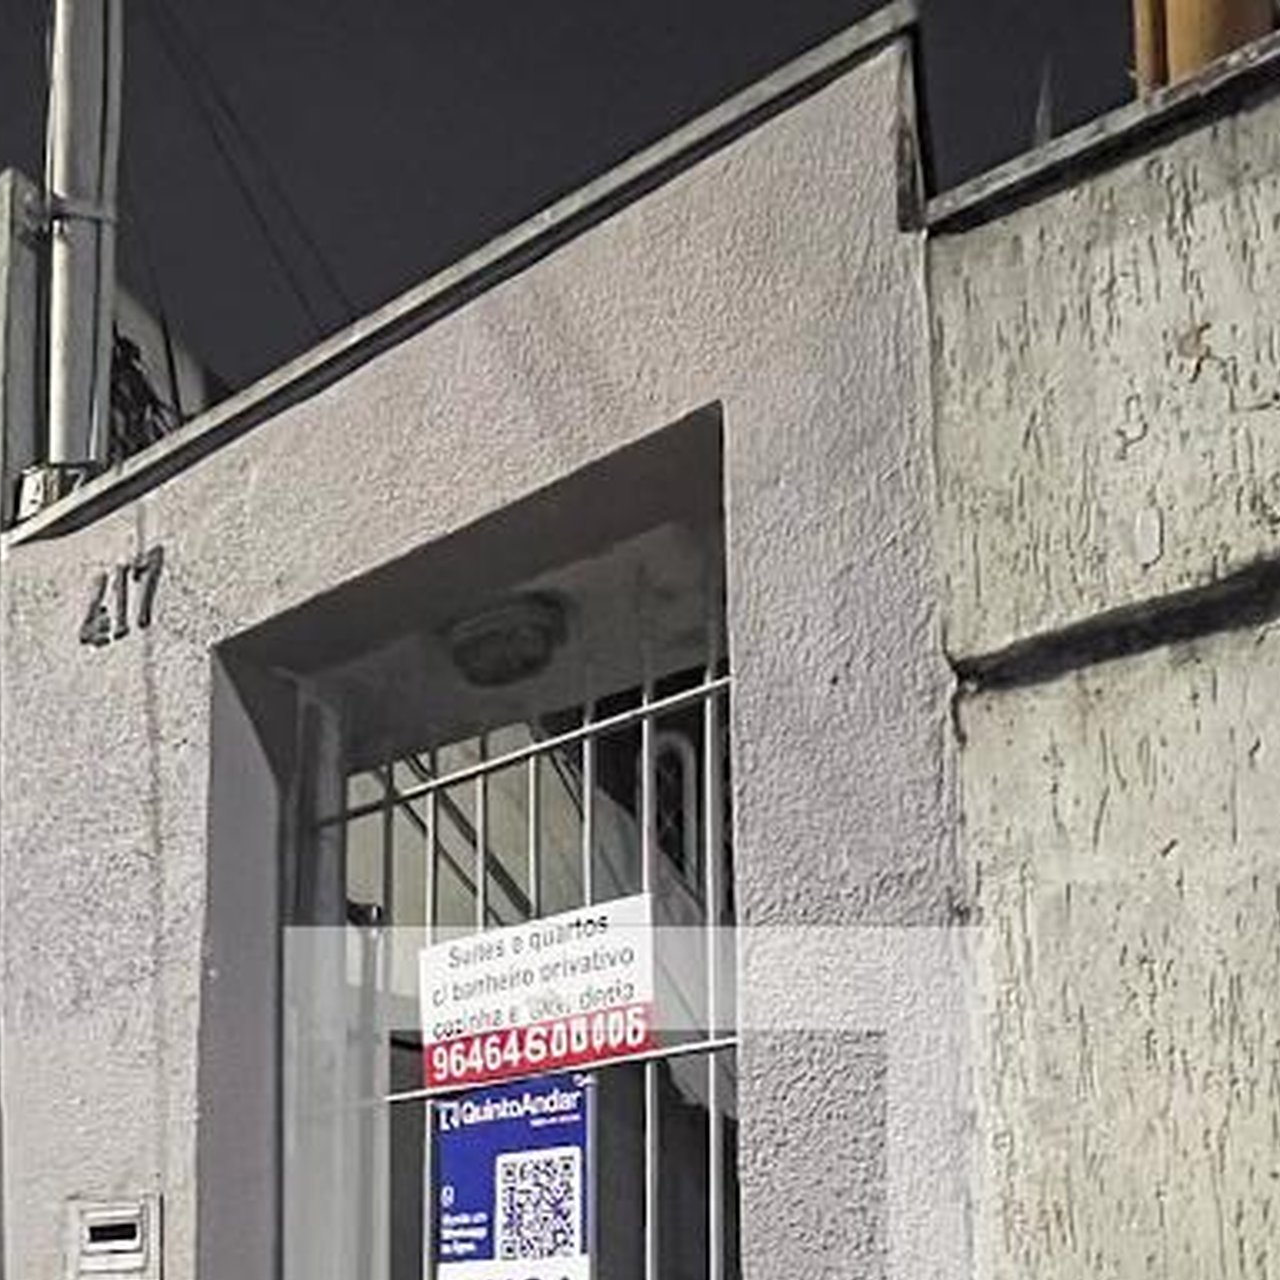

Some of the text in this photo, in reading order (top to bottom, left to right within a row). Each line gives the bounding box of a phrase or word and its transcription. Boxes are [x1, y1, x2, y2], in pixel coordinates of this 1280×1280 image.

[528, 915, 609, 953] quartos
[452, 962, 535, 1003] banheiro
[539, 945, 635, 983] privativo
[432, 1007, 503, 1041] cozinha
[461, 1088, 582, 1125] QuintoAndar
